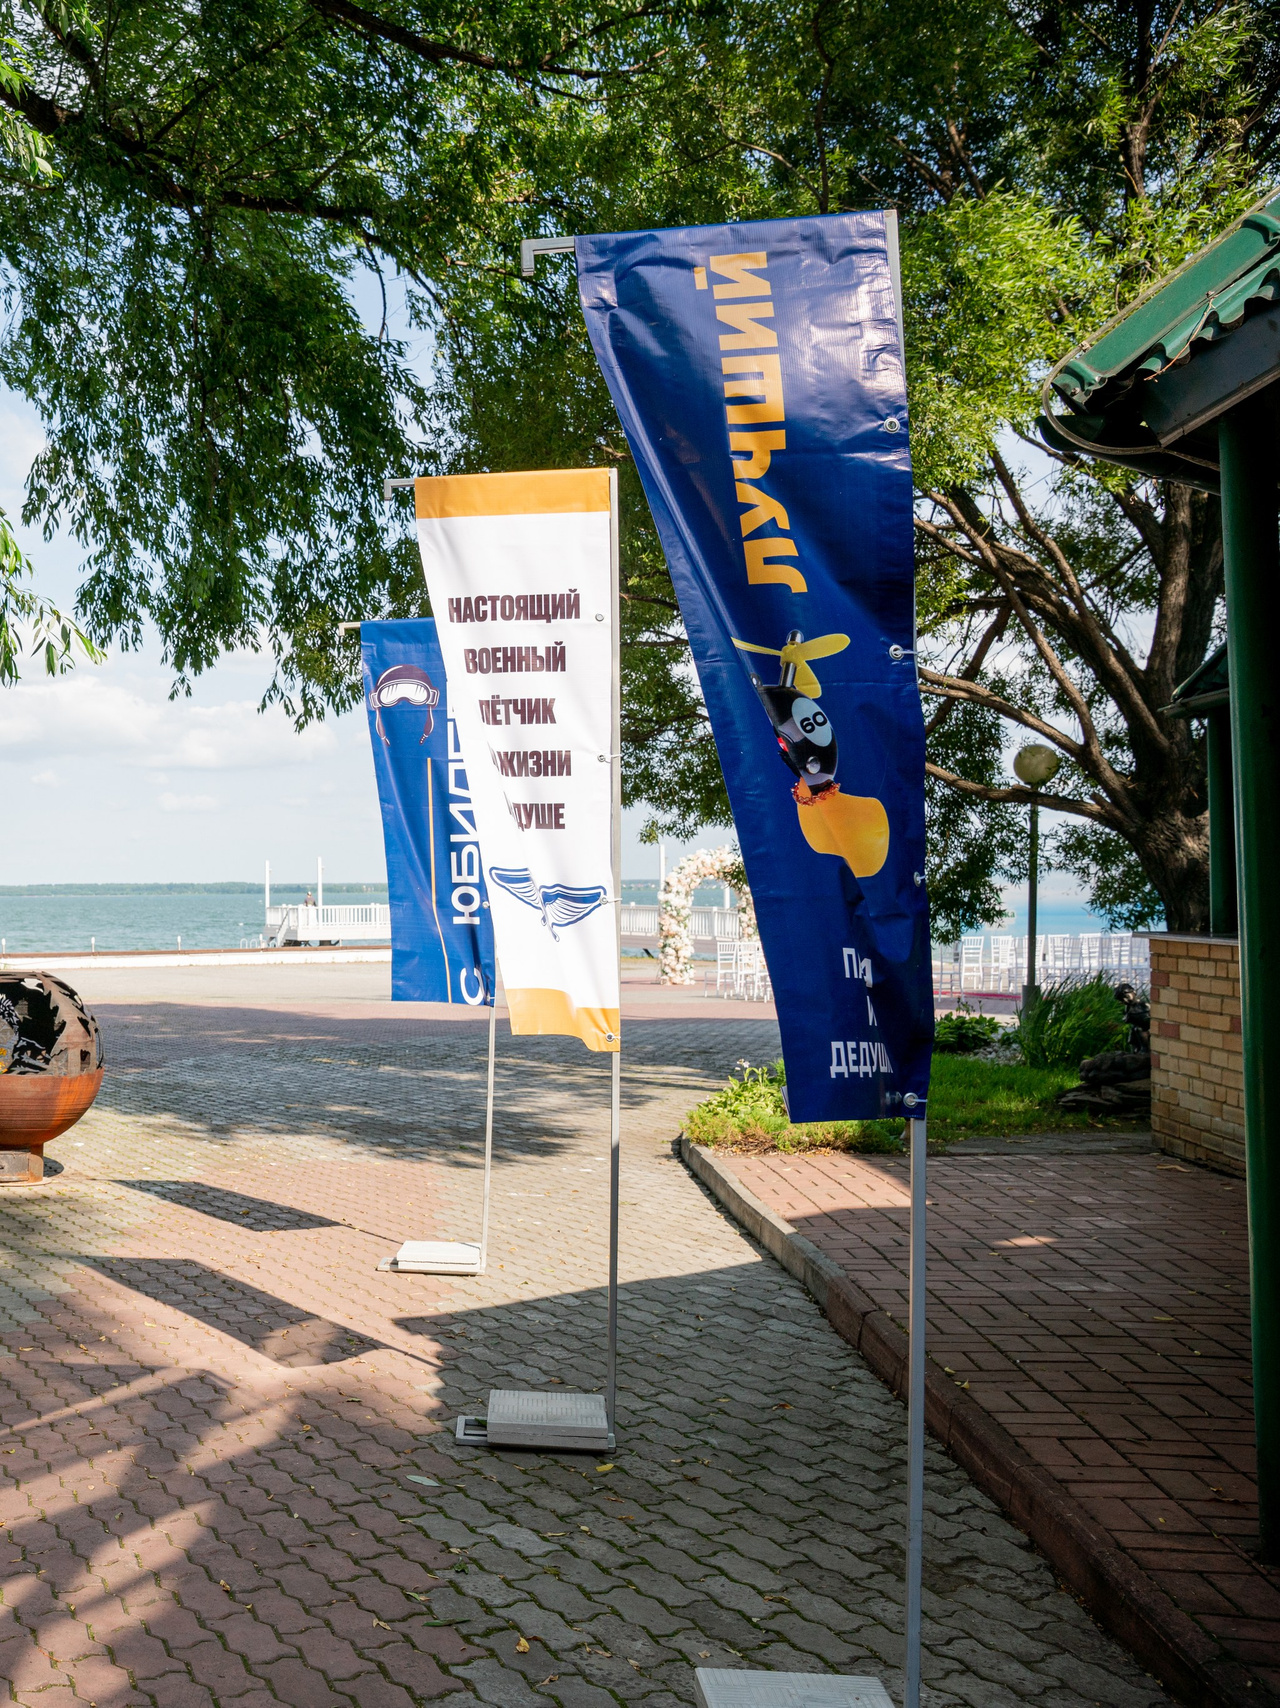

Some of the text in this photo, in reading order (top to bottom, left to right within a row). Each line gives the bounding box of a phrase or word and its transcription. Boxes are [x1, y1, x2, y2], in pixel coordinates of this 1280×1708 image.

[693, 251, 808, 593] ЛУЧШИЙ
[447, 588, 581, 623] НАСТОЯЩИЙ
[463, 641, 566, 675] ВОЕННЫЙ
[800, 711, 828, 734] 60
[496, 750, 572, 778] ЖИЗНИ
[460, 968, 484, 1005] С
